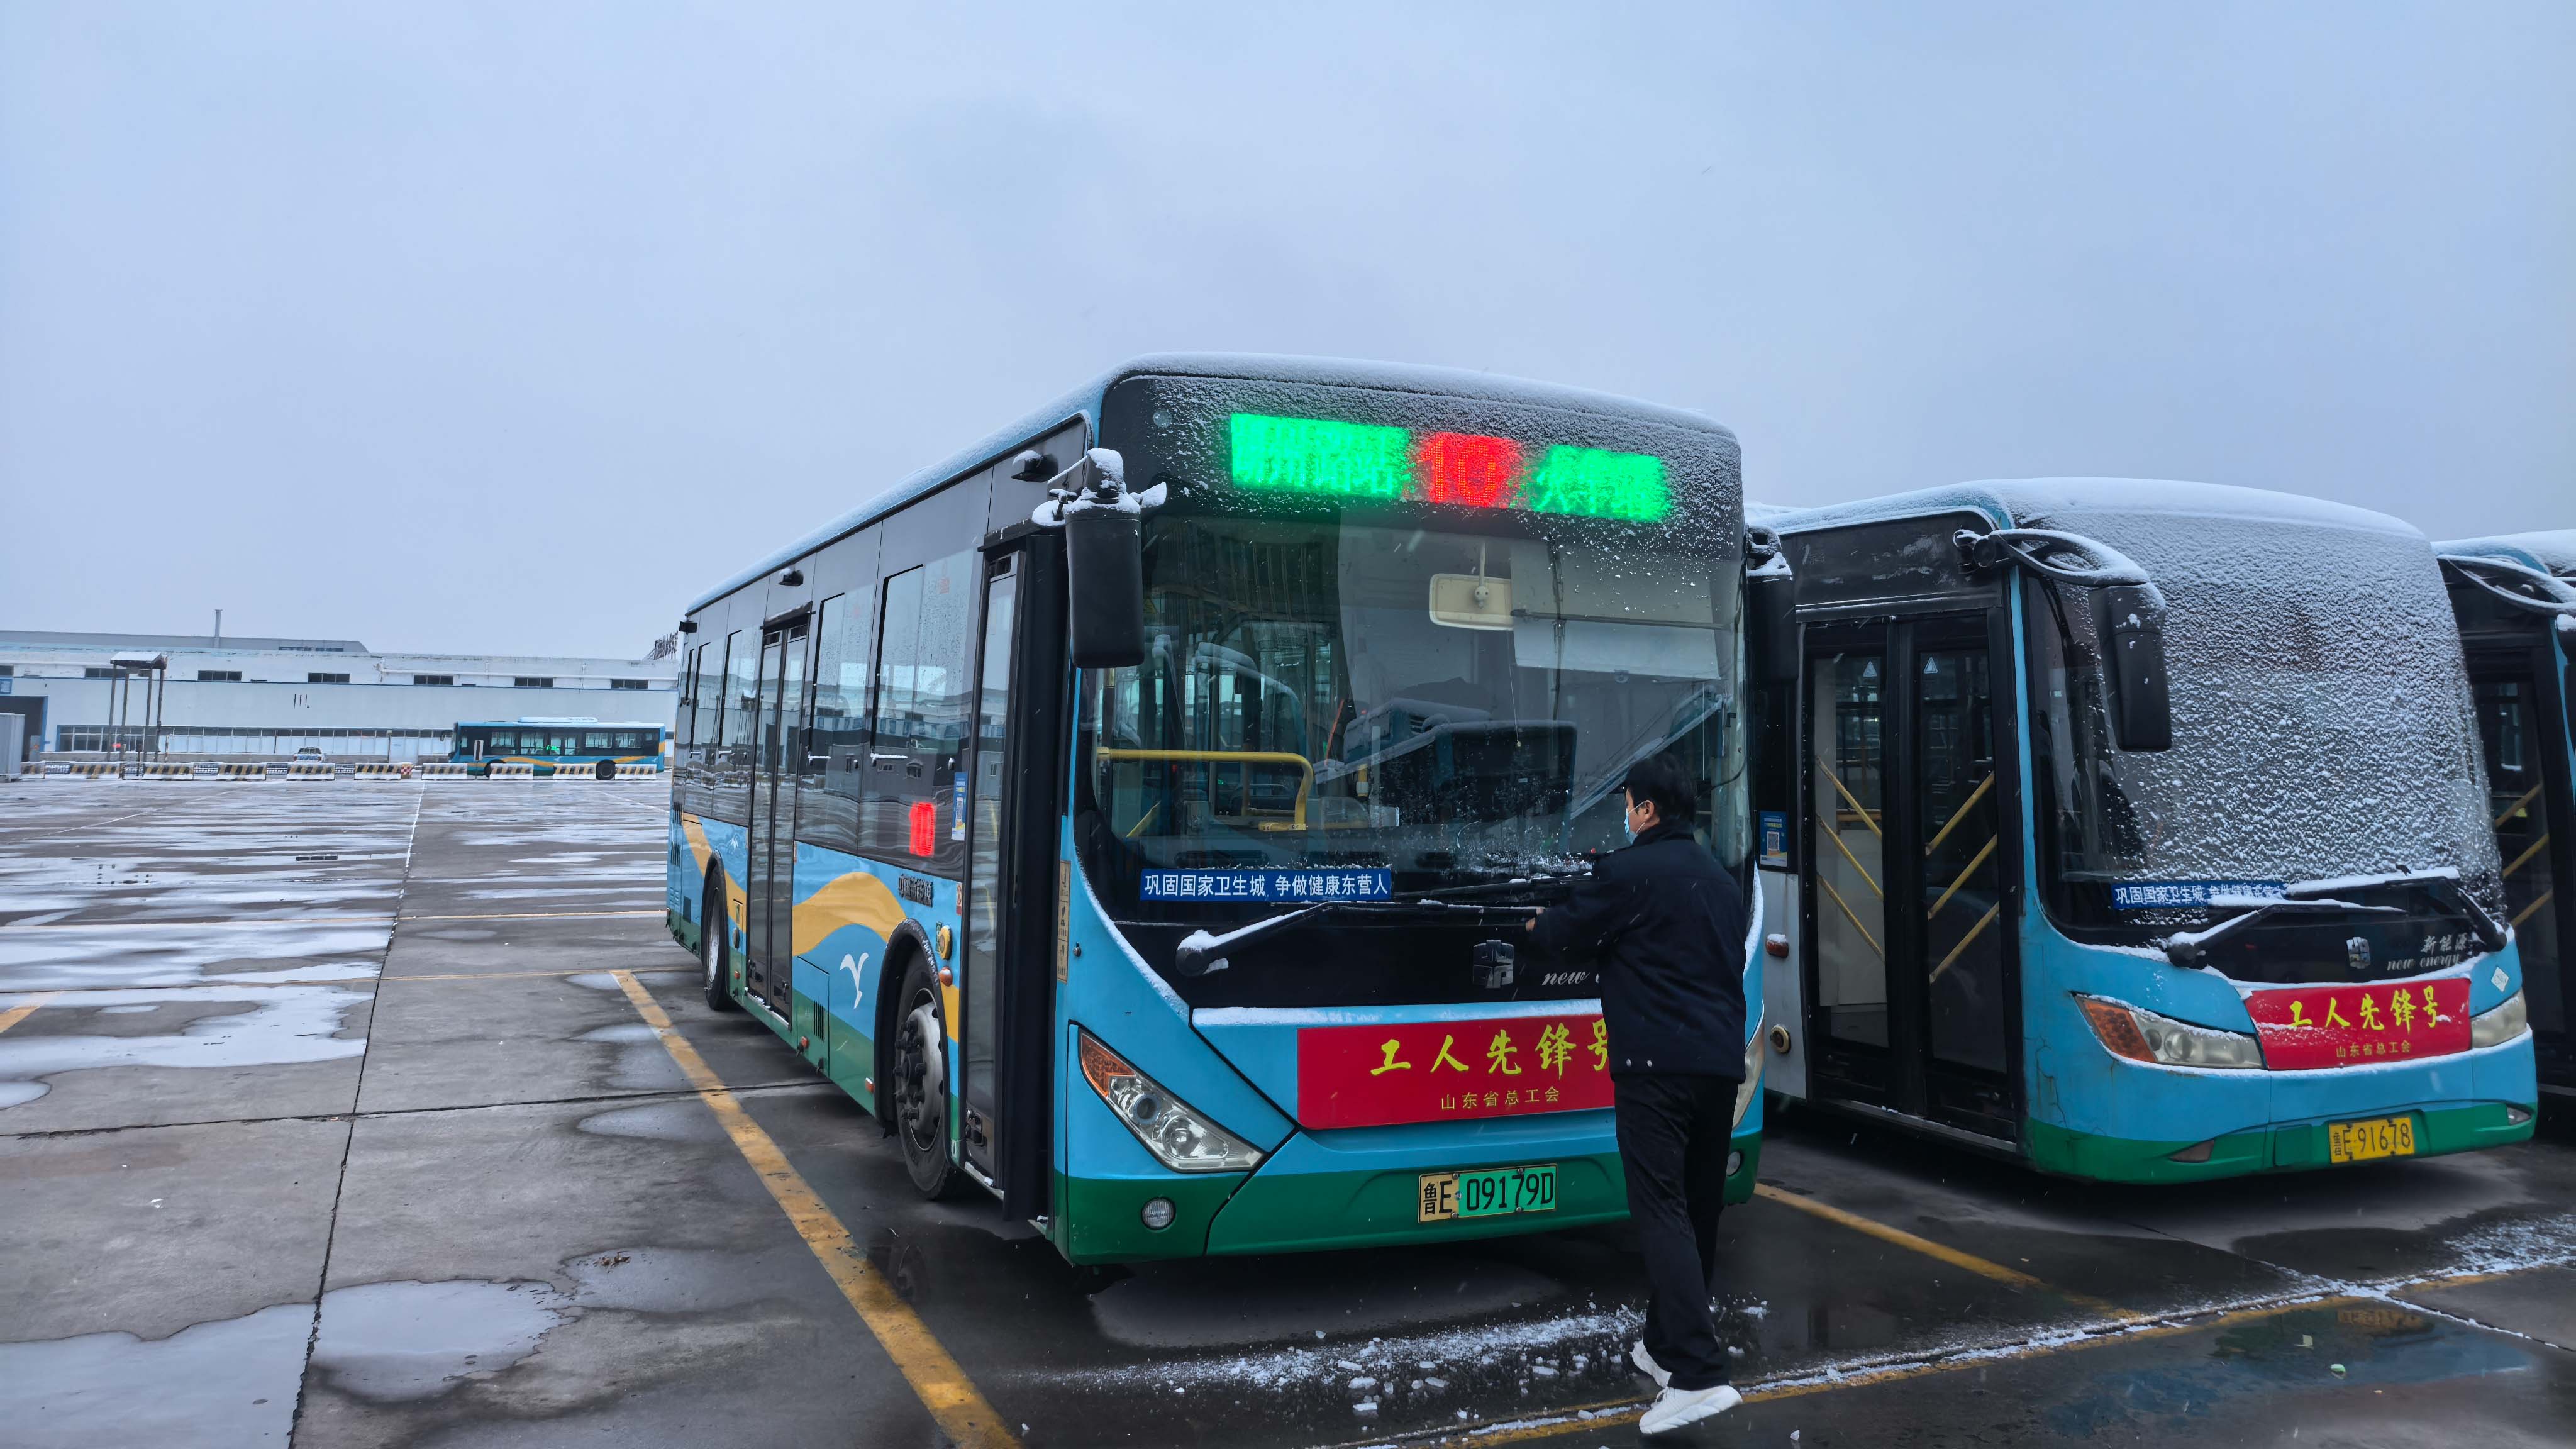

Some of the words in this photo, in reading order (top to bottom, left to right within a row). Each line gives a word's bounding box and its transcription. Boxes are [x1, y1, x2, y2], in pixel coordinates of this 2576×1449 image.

[1419, 435, 1500, 505] 10
[1145, 874, 1265, 896] 巩固国家卫生城
[1275, 874, 1388, 896] 争做健康东营人
[2421, 933, 2467, 954] 新能源
[2386, 958, 2415, 971] new
[2419, 953, 2460, 967] energy
[1541, 971, 1590, 986] new
[2289, 985, 2438, 1034] 工人先锋号
[1370, 1018, 1609, 1079] 工人先锋号
[2336, 1040, 2411, 1058] 山东省总工会
[1441, 1086, 1559, 1110] 山东省总工会
